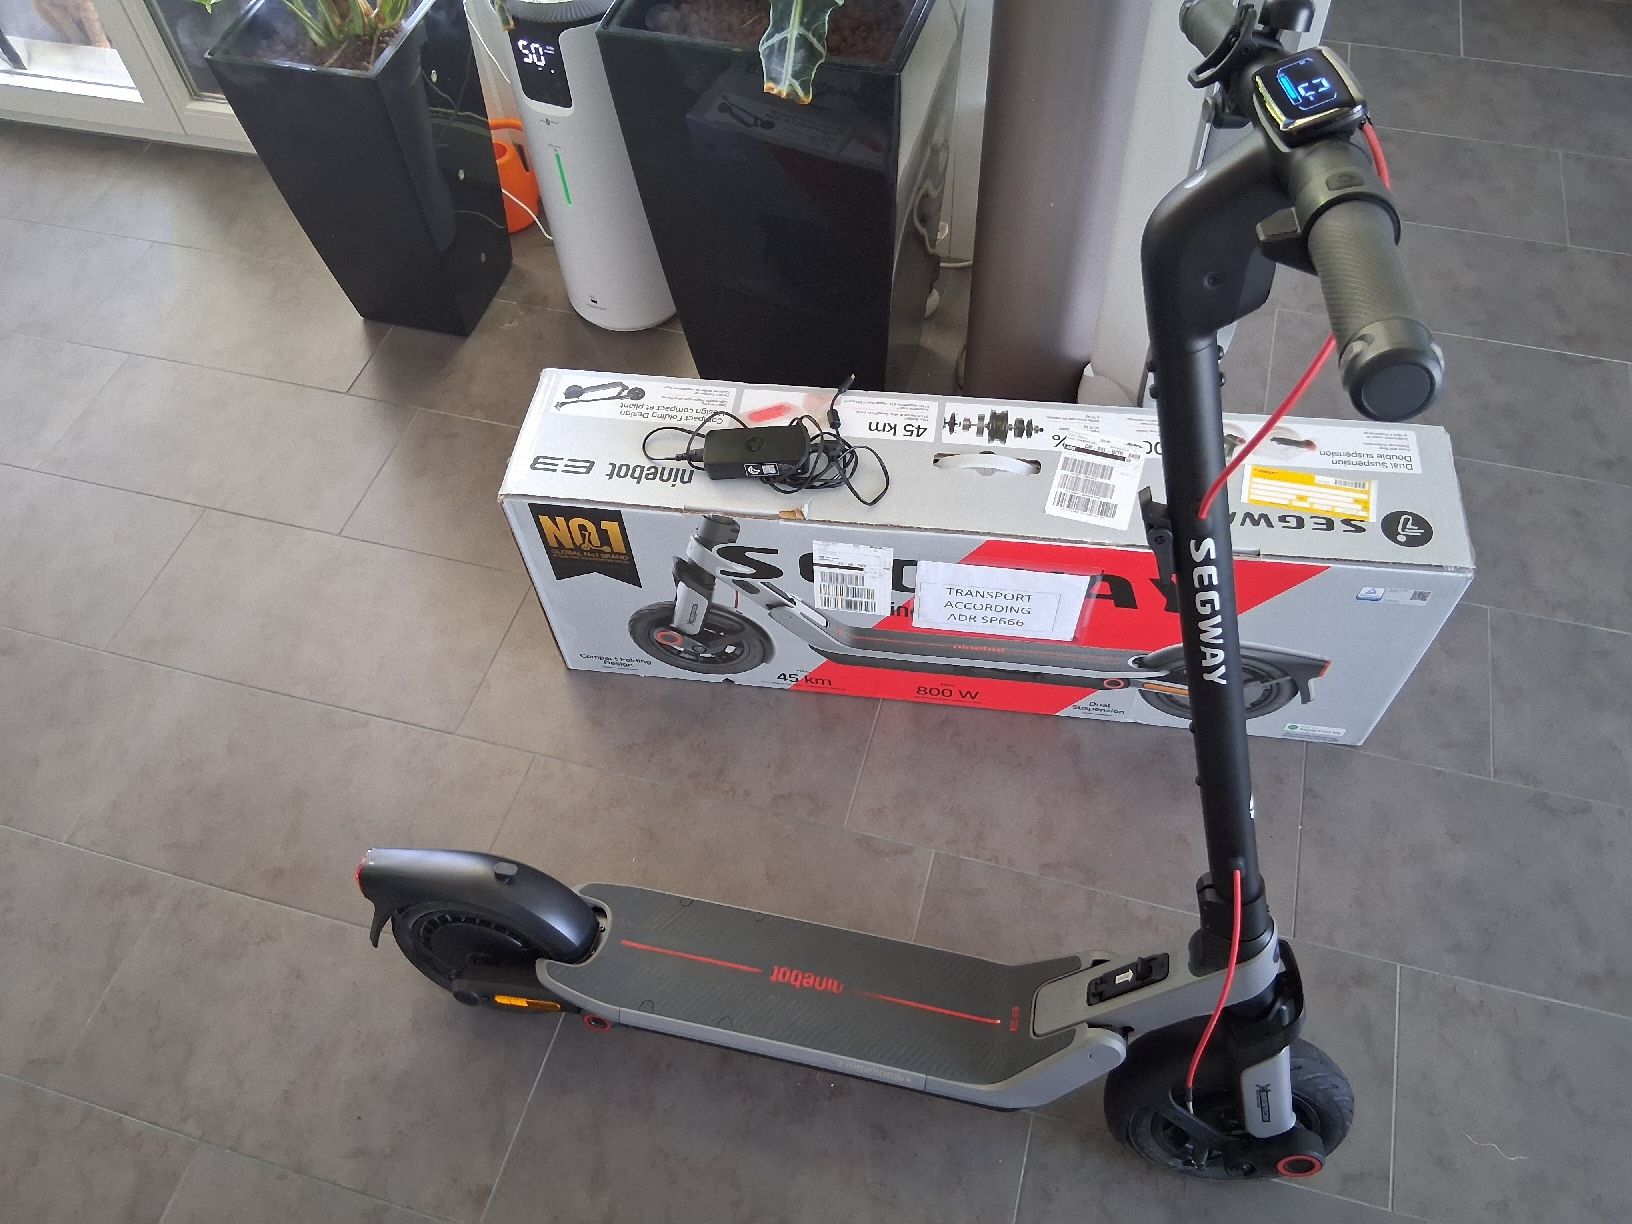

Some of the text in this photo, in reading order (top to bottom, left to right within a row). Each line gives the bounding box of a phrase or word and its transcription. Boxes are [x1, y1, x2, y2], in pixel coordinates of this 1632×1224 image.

[517, 39, 546, 67] 50
[620, 402, 645, 411] pliant
[656, 404, 694, 414] compact
[619, 409, 650, 419] Design
[651, 411, 683, 422] Folding
[868, 421, 928, 437] 45 km
[1319, 450, 1412, 462] Double suspension
[1331, 458, 1414, 471] Dual Suspension
[530, 455, 695, 488] ninebot E3
[945, 586, 1033, 603] TRANSPORT
[943, 600, 1032, 615] ACCORDING
[1190, 538, 1227, 685] SEGWAY
[946, 613, 977, 625] ADR
[776, 672, 832, 686] 45 km
[916, 686, 953, 698] 800
[958, 690, 980, 700] W
[1072, 704, 1125, 715] Suspension
[1088, 701, 1111, 709] Dual
[768, 964, 845, 995] ninebot
